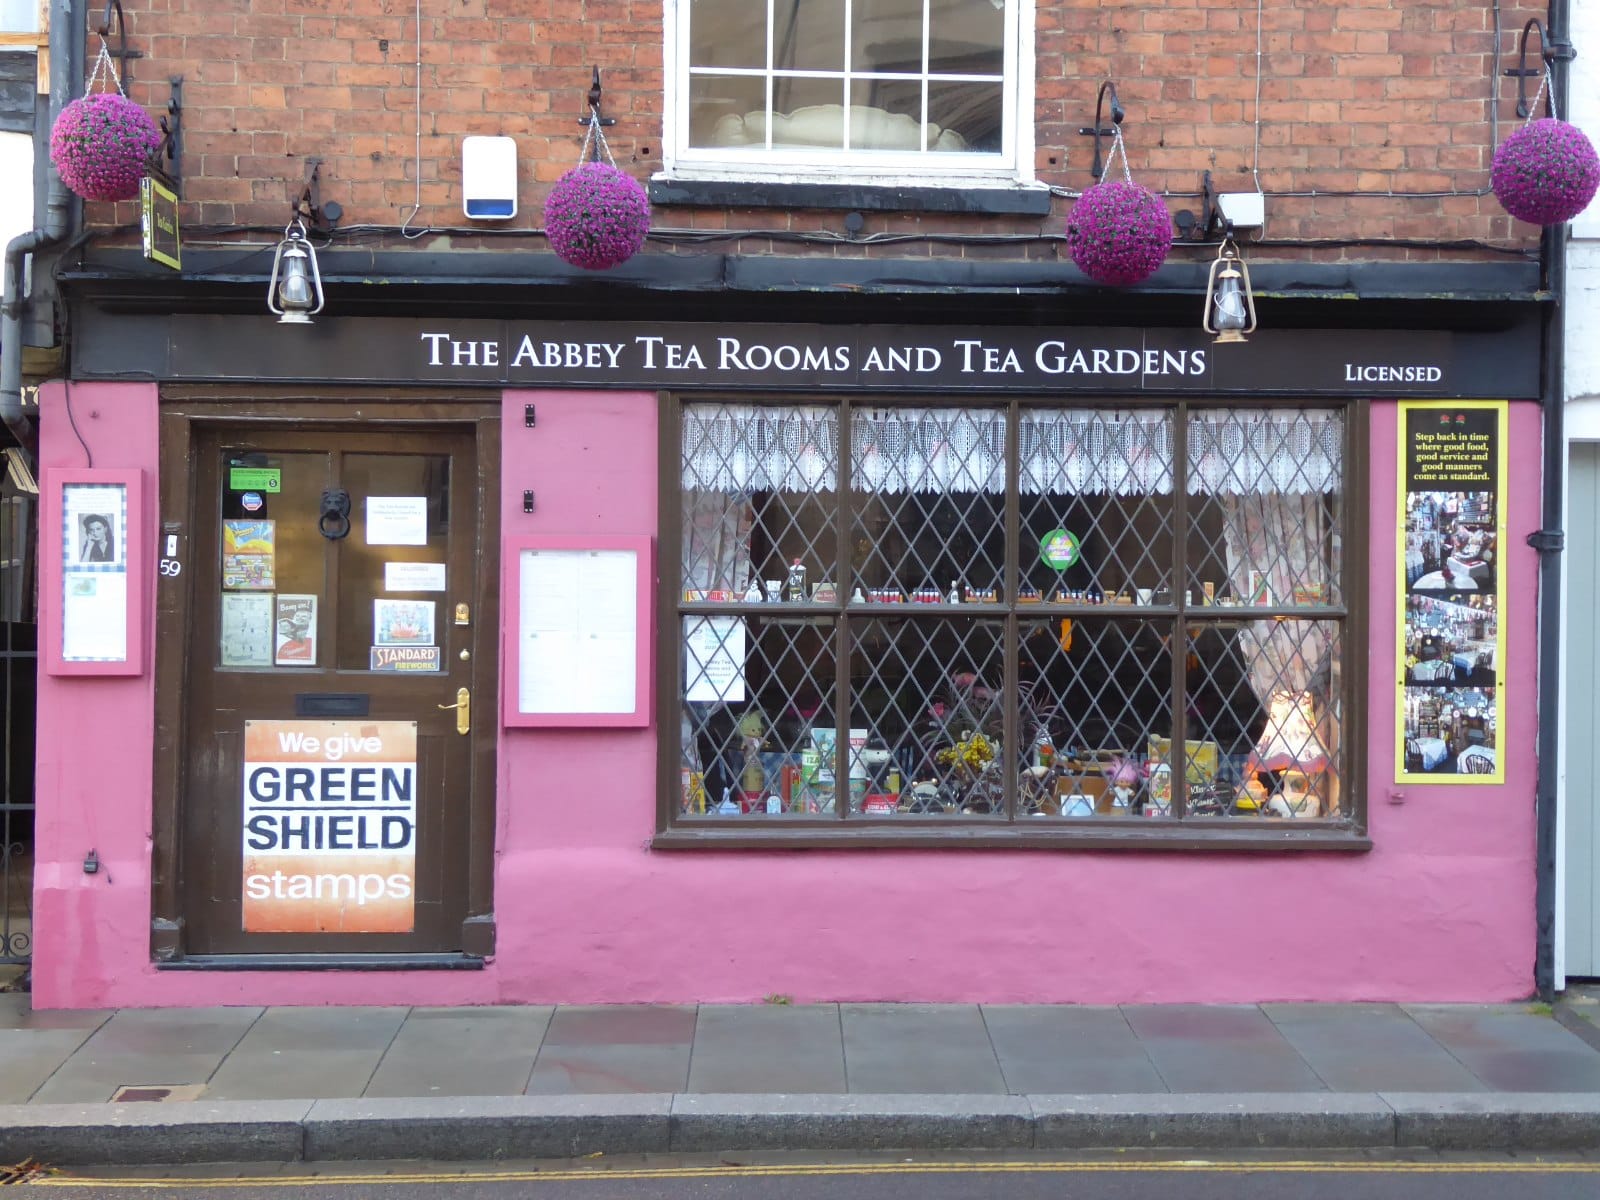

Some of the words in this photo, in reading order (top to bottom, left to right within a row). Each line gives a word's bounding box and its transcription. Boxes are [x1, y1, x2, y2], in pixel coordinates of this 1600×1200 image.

[1035, 341, 1205, 375] GARDENS
[1415, 432, 1435, 443] Step
[1436, 432, 1457, 441] back
[1459, 432, 1468, 441] in
[1469, 432, 1490, 441] time
[1415, 442, 1442, 451] where
[1443, 442, 1465, 452] good
[1466, 442, 1489, 452] food,
[1416, 452, 1437, 462] good
[1439, 452, 1470, 461] service
[1471, 452, 1488, 461] and
[1422, 462, 1443, 472] good
[1445, 463, 1483, 471] manners
[1413, 473, 1437, 481] come
[1438, 473, 1448, 481] as
[1450, 472, 1490, 481] standard.
[160, 559, 181, 577] 59
[377, 648, 435, 667] STANDARD
[395, 662, 436, 670] FIREWORKS
[279, 731, 320, 753] We
[324, 732, 382, 761] give
[248, 766, 412, 803] GREEN
[247, 814, 411, 851] SHIELD
[246, 870, 411, 905] stamps
